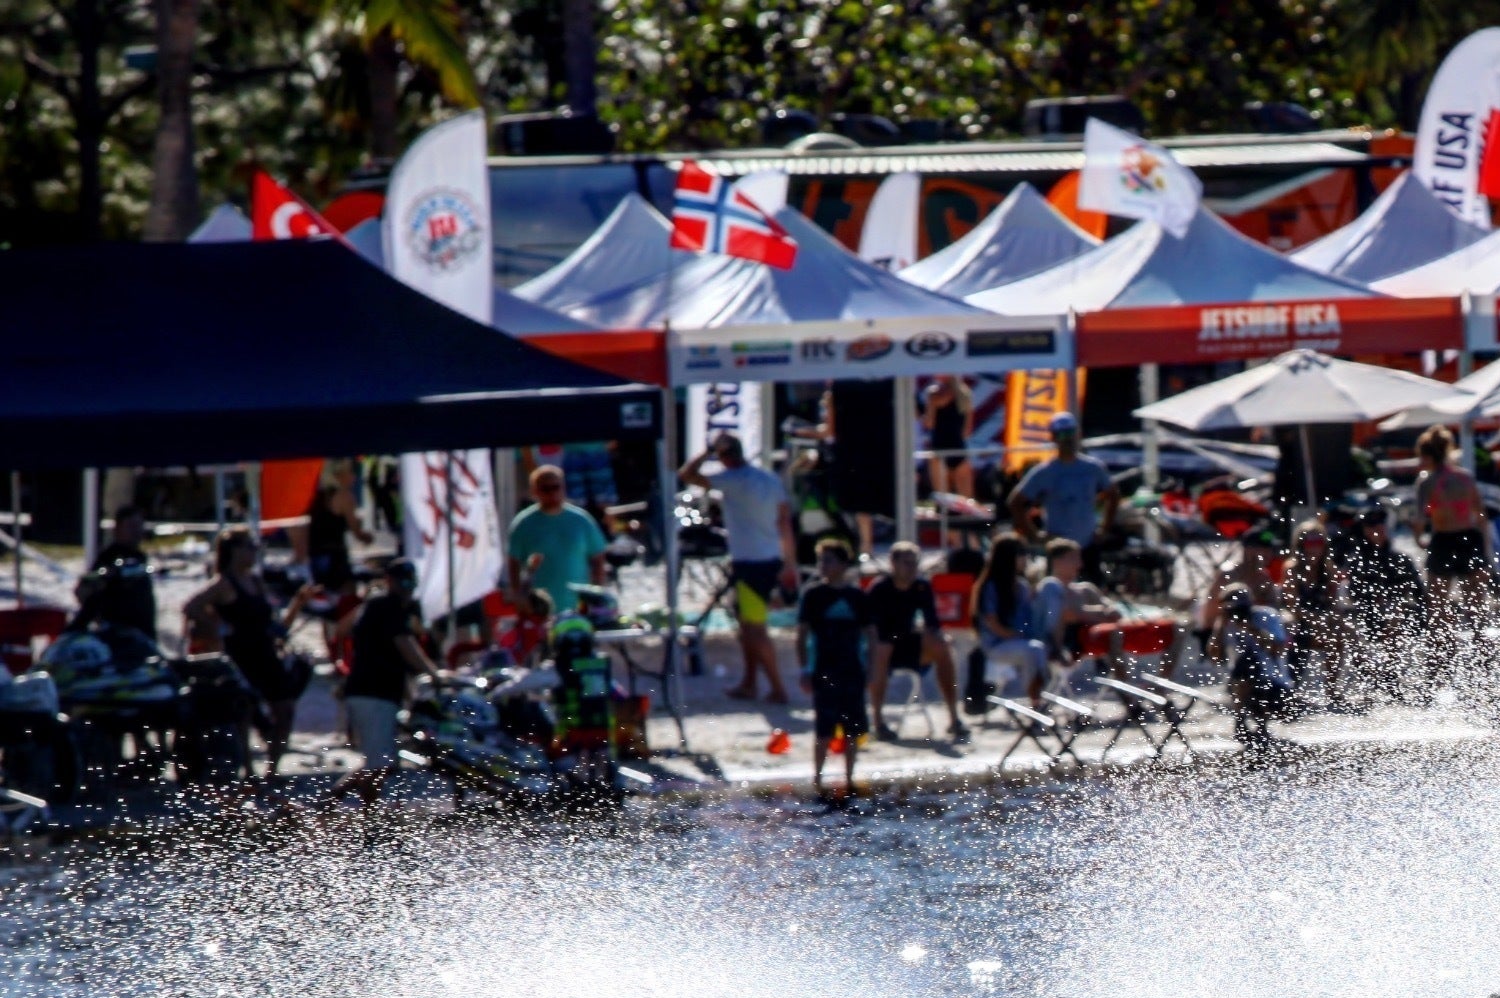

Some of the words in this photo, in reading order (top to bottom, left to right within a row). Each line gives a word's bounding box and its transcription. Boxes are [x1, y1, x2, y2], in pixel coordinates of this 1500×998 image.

[1433, 113, 1474, 169] USA
[1198, 304, 1290, 341] JETSURF
[1293, 302, 1342, 336] USA
